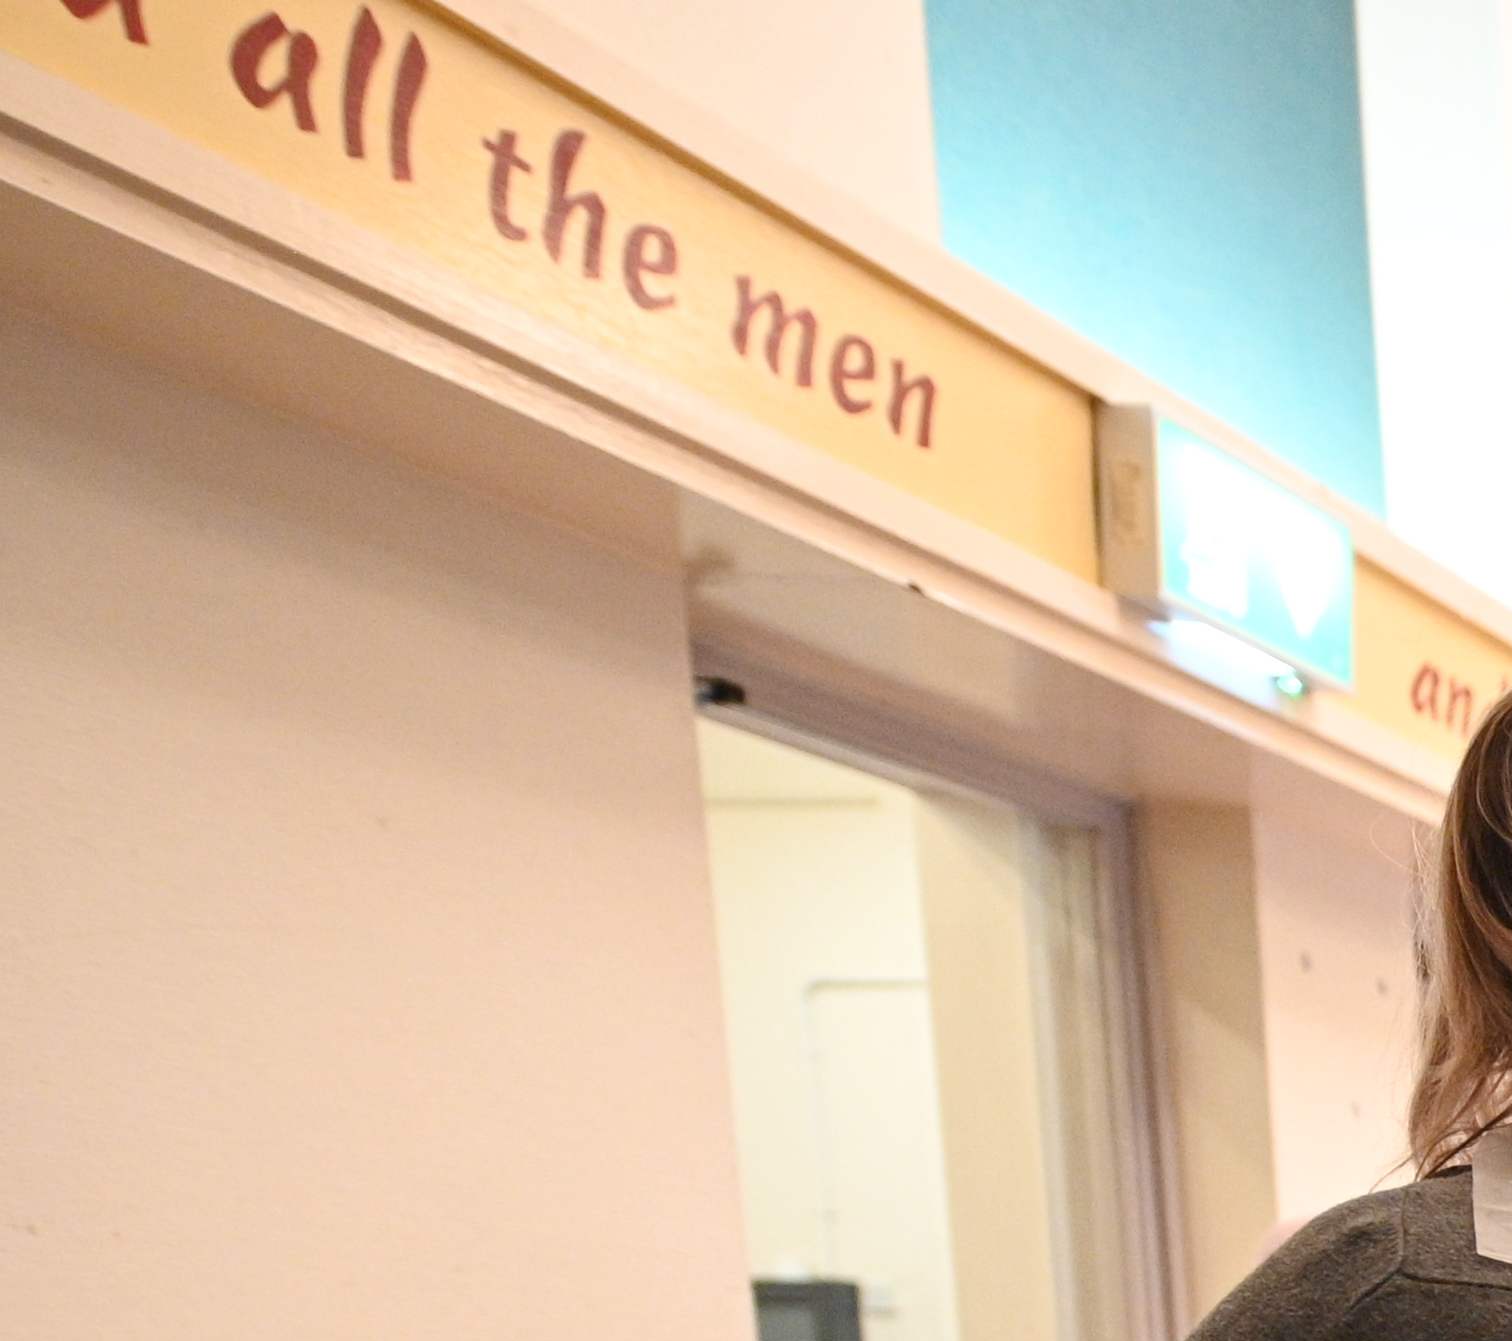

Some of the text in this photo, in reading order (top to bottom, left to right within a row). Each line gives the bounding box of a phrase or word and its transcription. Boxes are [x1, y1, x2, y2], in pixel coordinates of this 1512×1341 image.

[229, 6, 937, 450] all the men
